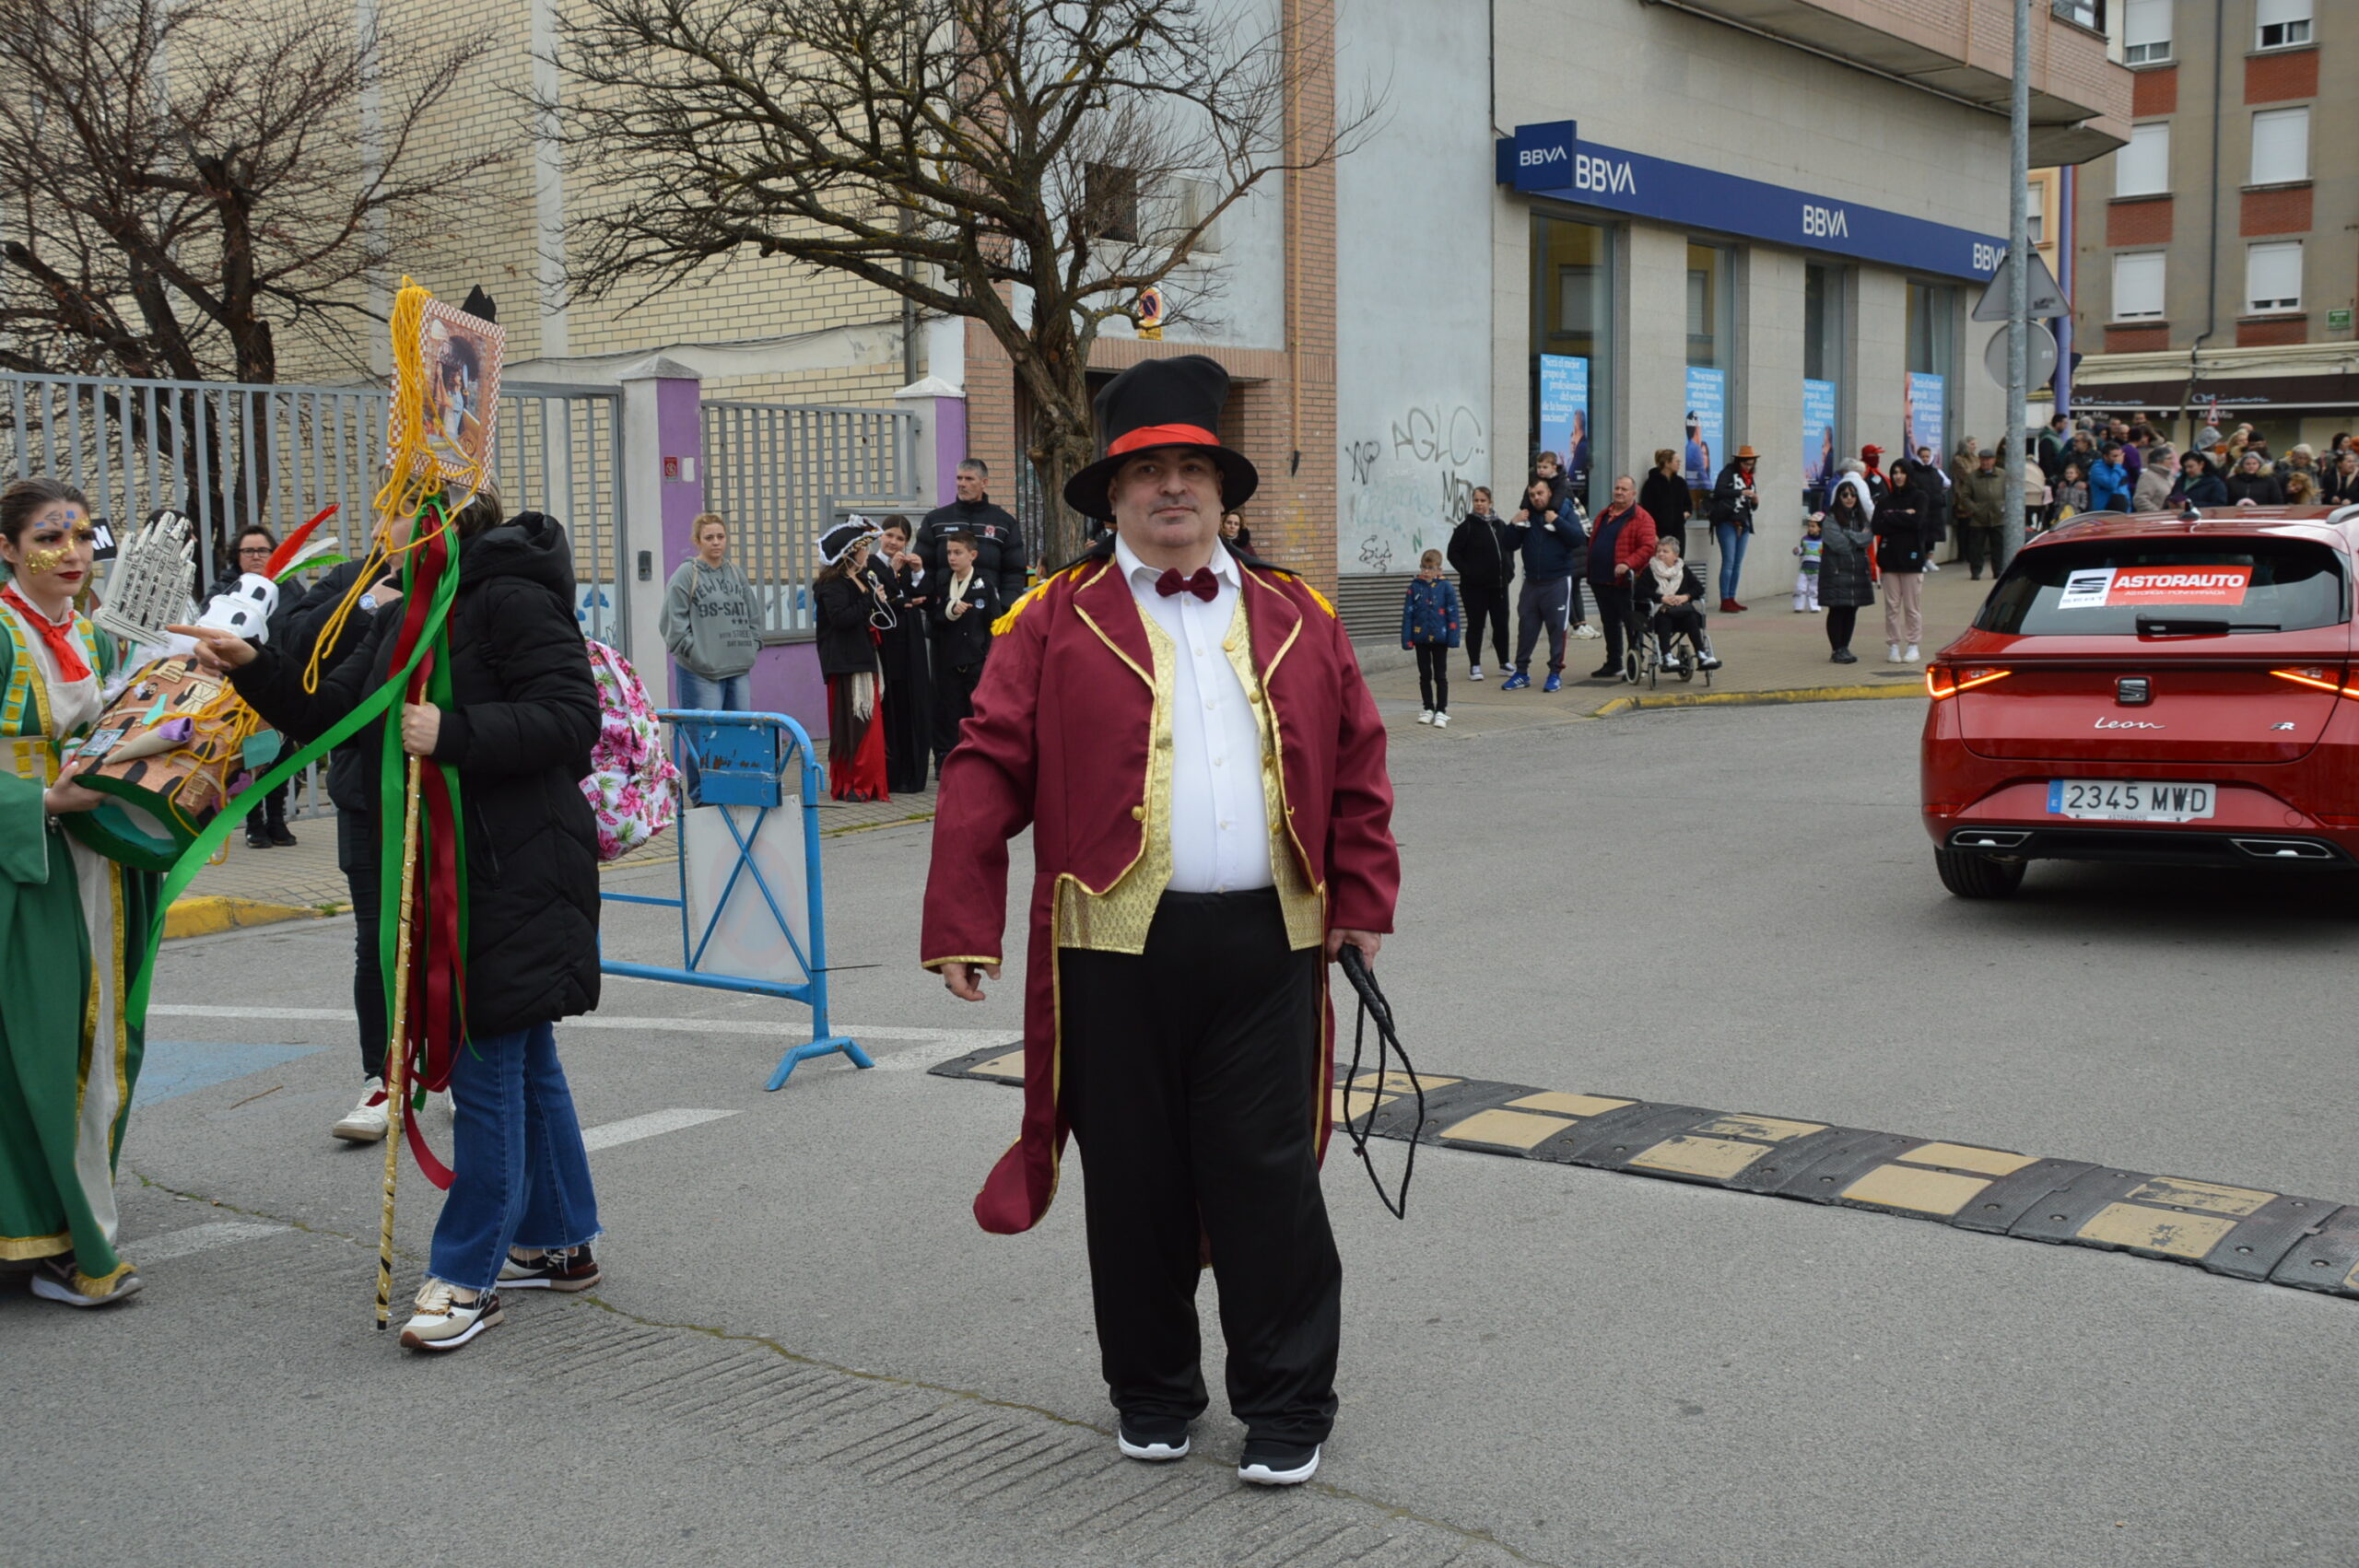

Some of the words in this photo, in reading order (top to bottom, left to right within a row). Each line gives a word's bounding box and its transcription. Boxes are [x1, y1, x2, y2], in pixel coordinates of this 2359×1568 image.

[1520, 146, 1567, 166] BBVA
[1575, 154, 1636, 194] BBVA
[1803, 205, 1848, 238] BBVA
[92, 524, 114, 550] N
[2114, 574, 2245, 589] ASTORAUTO
[2094, 717, 2165, 729] Leon
[2270, 722, 2295, 731] FR
[2068, 785, 2140, 810] 2345
[2152, 787, 2207, 813] MWD
